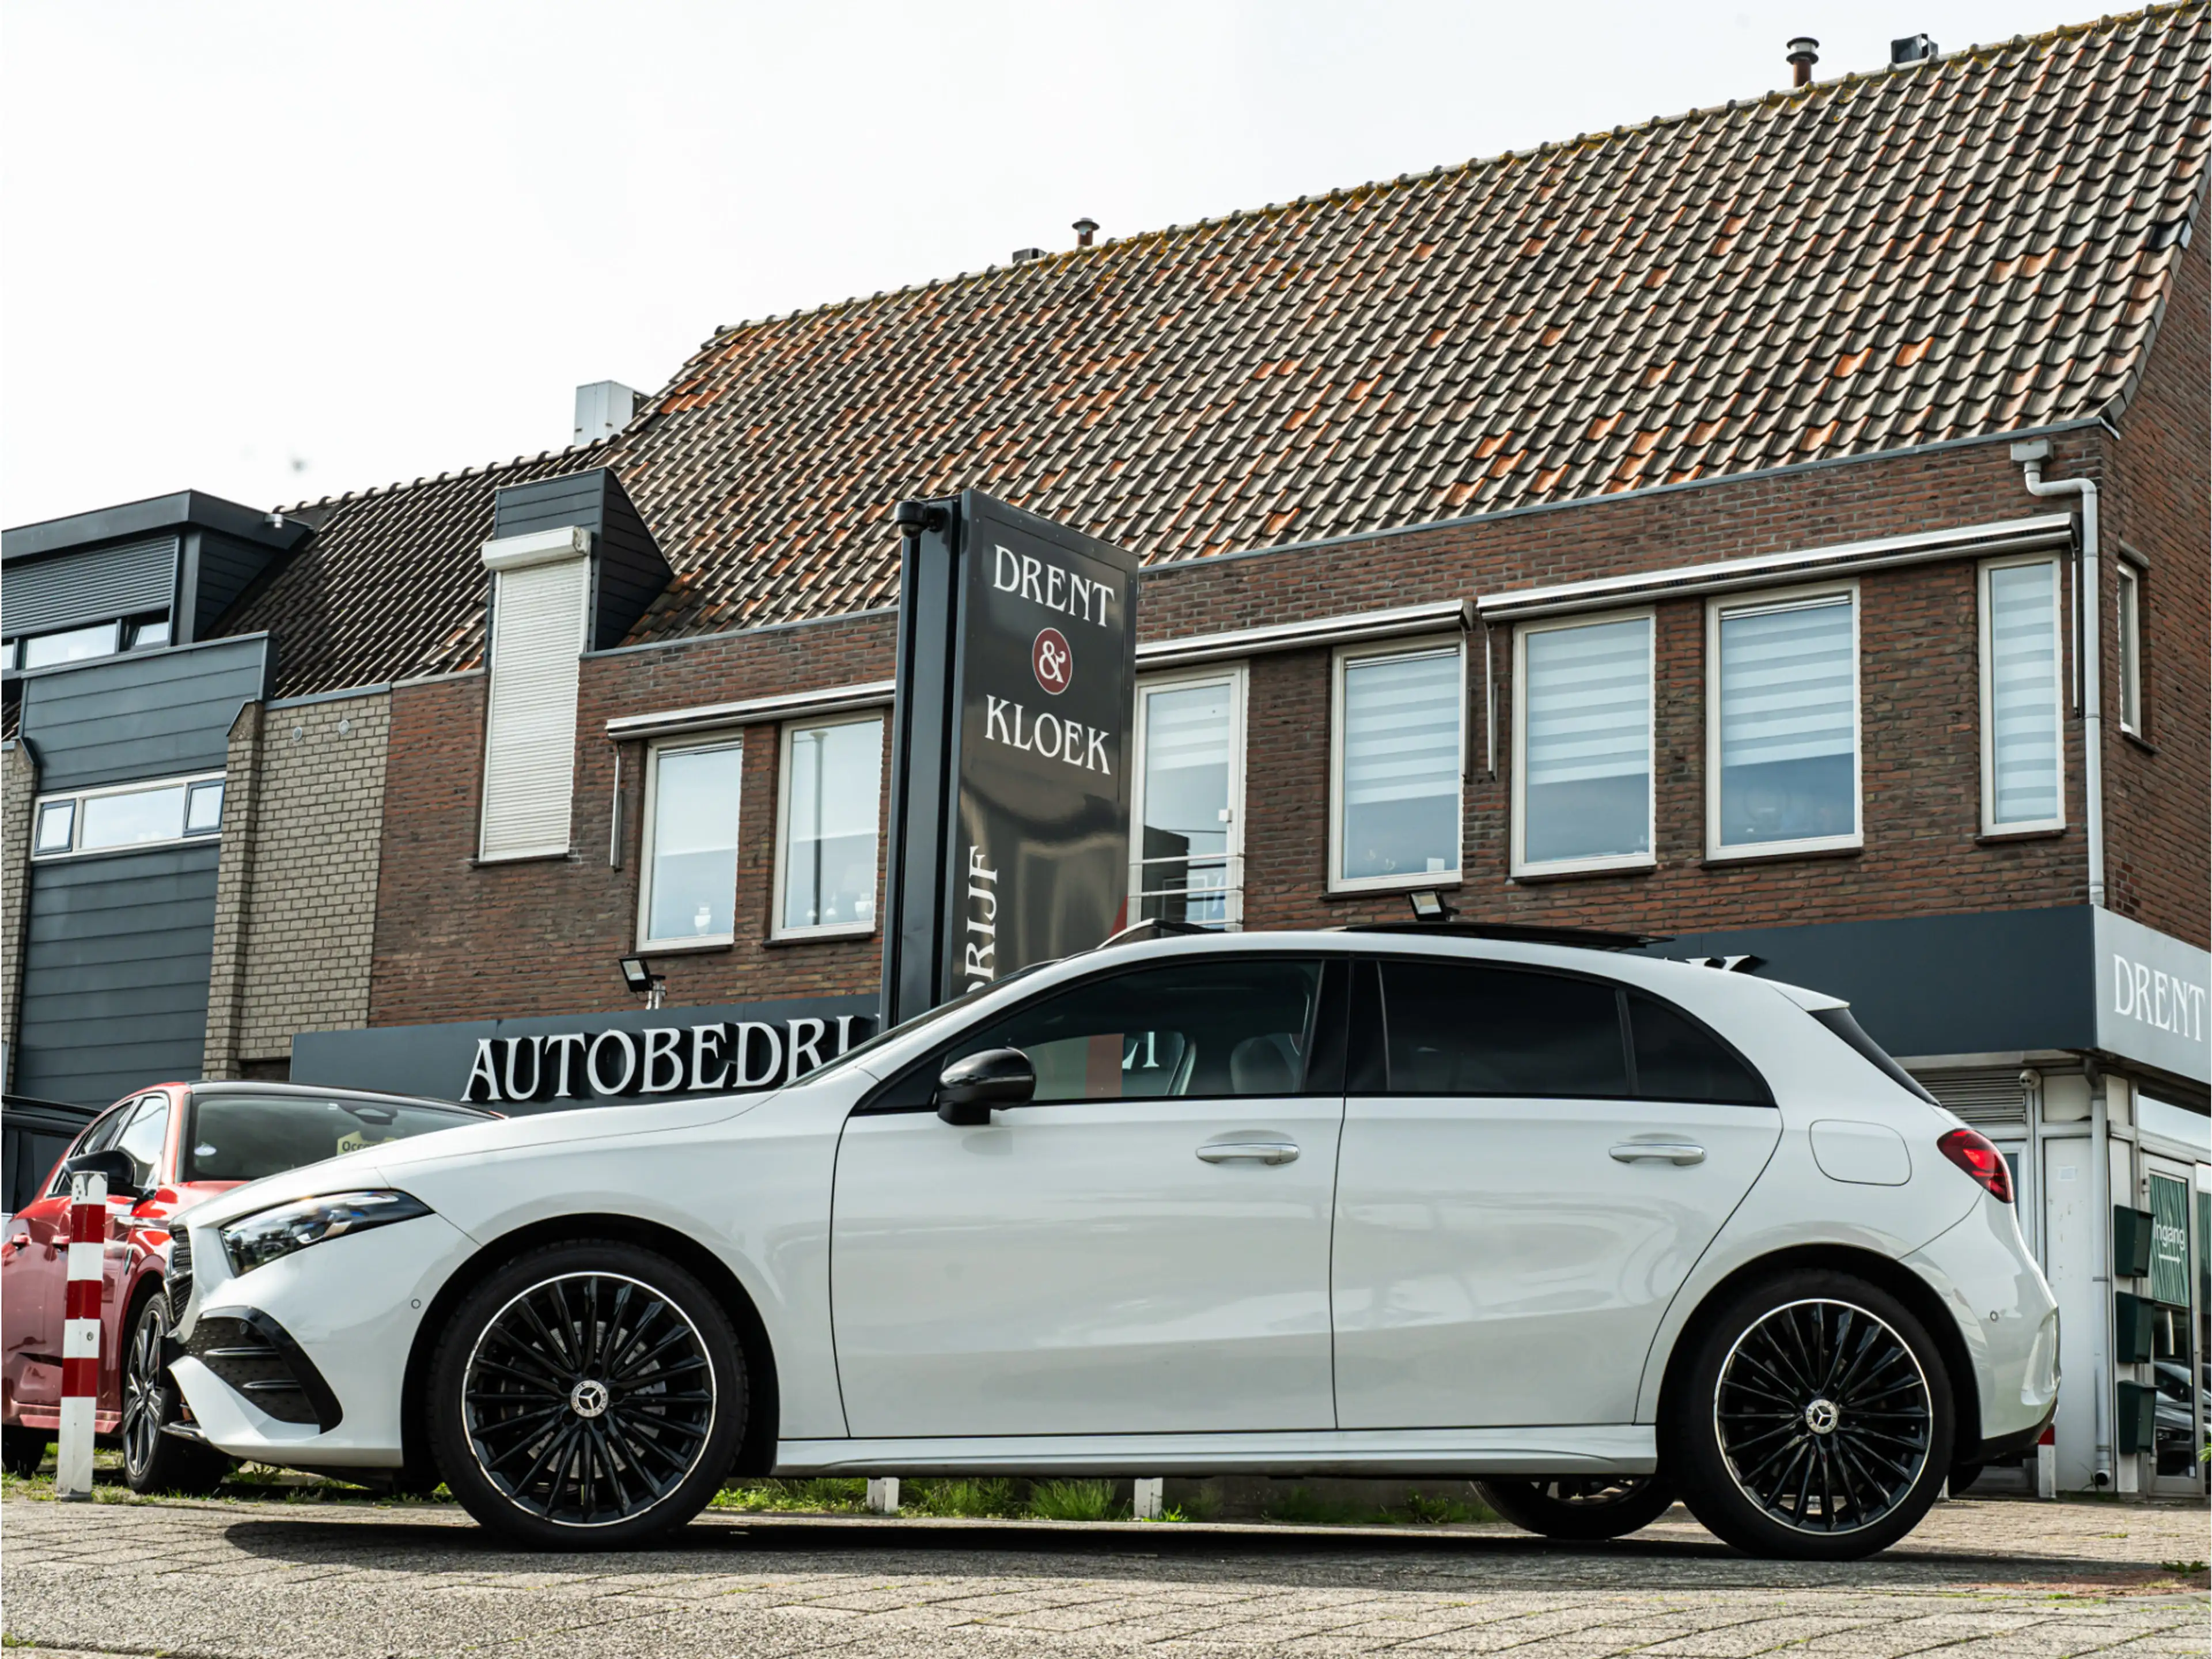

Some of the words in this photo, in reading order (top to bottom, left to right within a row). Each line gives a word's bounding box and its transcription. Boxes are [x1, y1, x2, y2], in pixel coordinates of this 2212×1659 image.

[993, 543, 1115, 628] DRENT
[1039, 639, 1066, 684] &
[984, 694, 1111, 775] KLOEK
[2113, 953, 2205, 1042] DRENT
[460, 1013, 881, 1103] AUTOBEDRI
